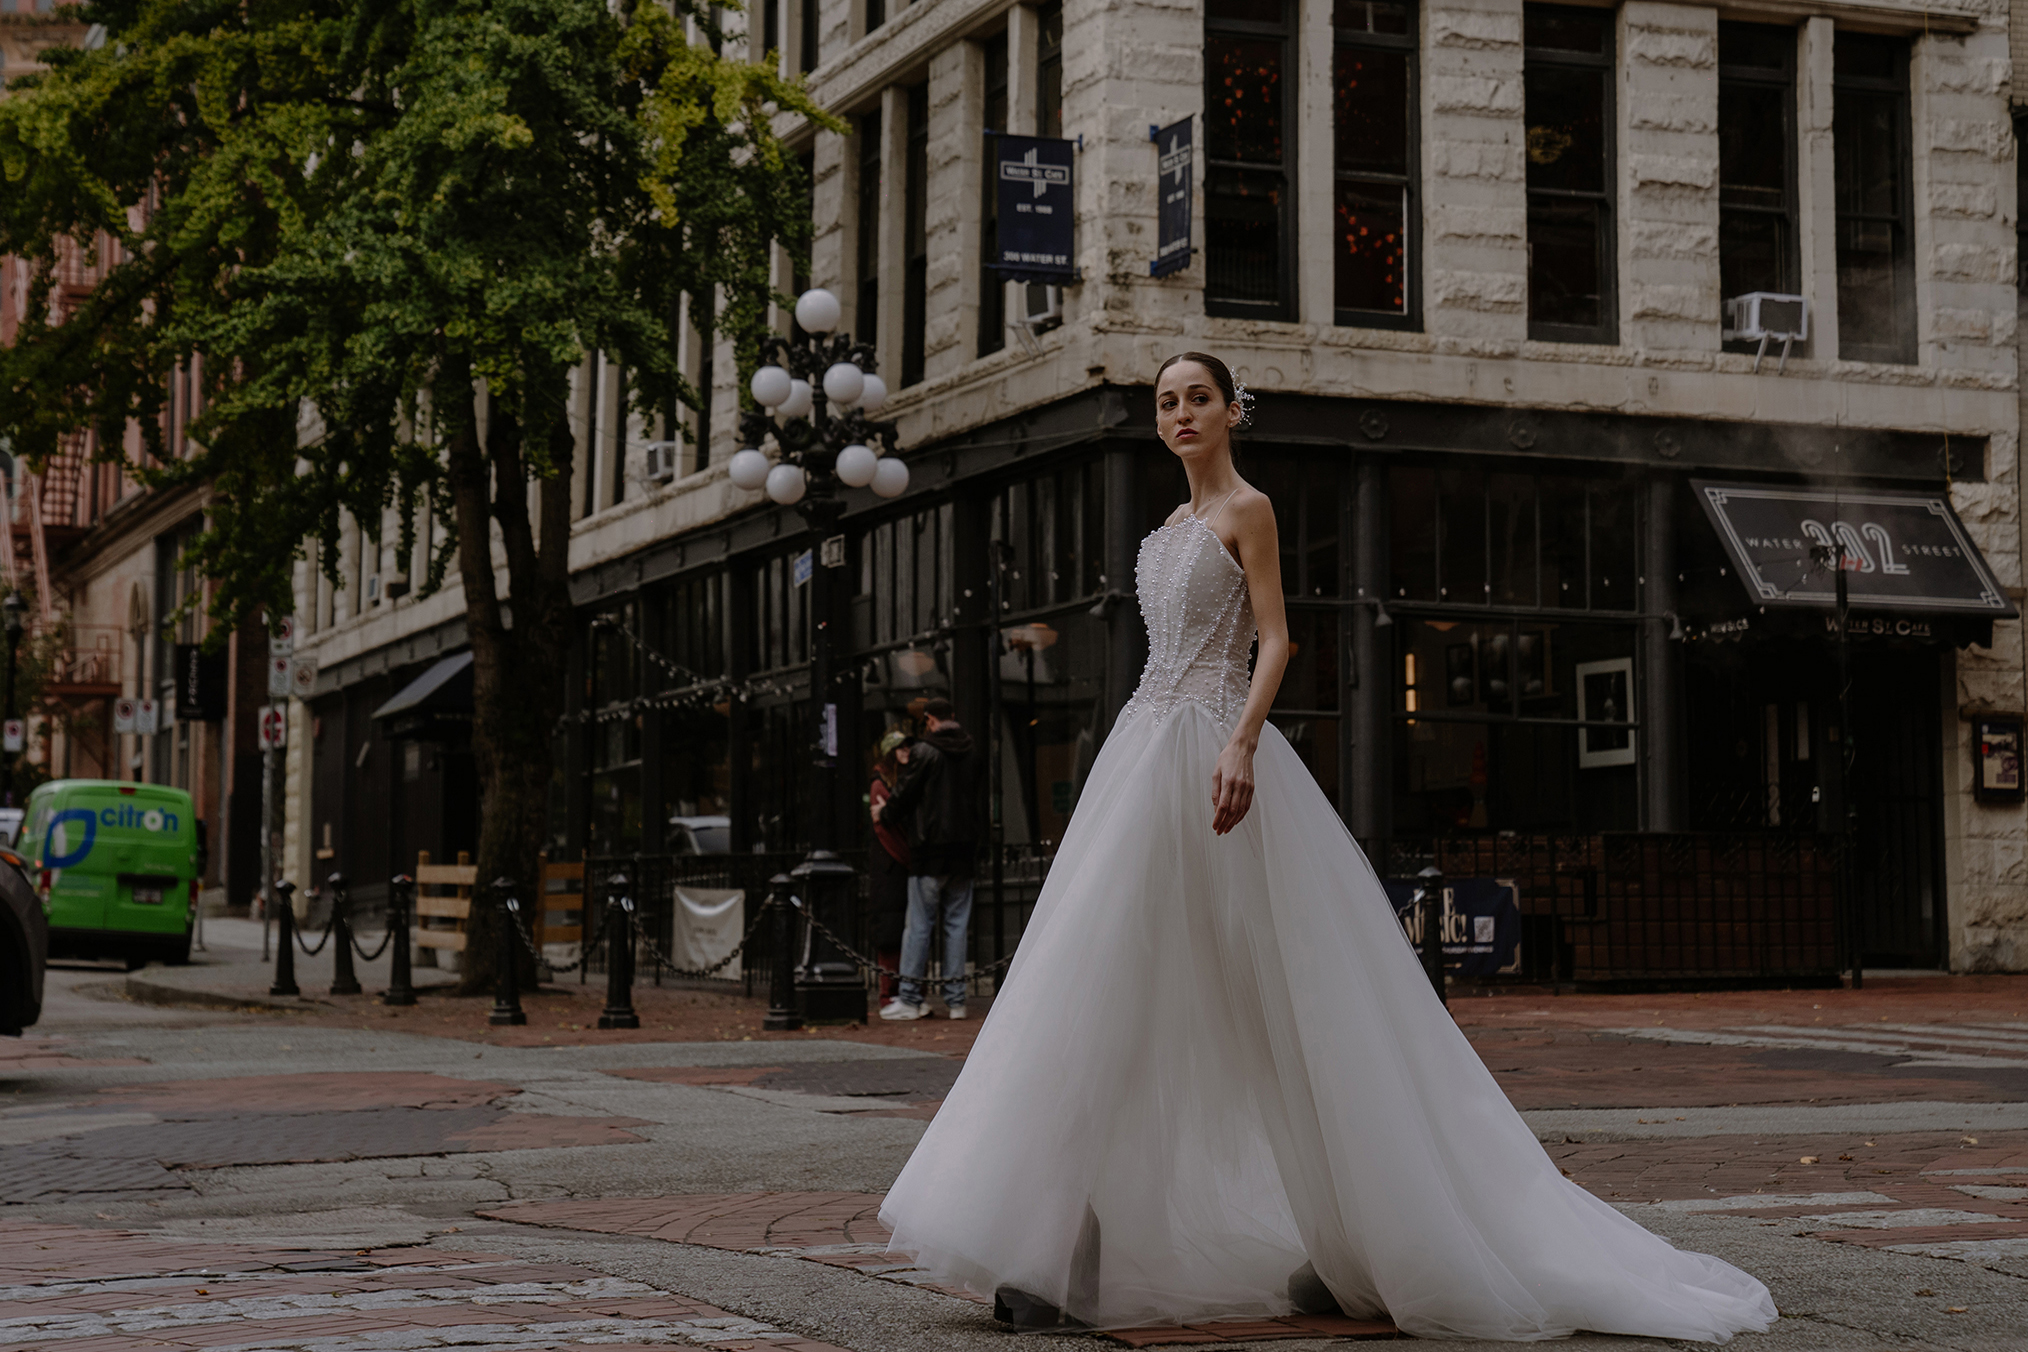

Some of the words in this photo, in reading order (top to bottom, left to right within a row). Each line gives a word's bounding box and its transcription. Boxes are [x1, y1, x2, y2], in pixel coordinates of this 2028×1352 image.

[1021, 252, 1054, 264] WATER
[1744, 537, 1803, 550] WATER
[1901, 544, 1960, 558] STREET
[1825, 616, 1869, 633] WTER
[1895, 619, 1931, 637] CAFE
[100, 803, 178, 832] citron
